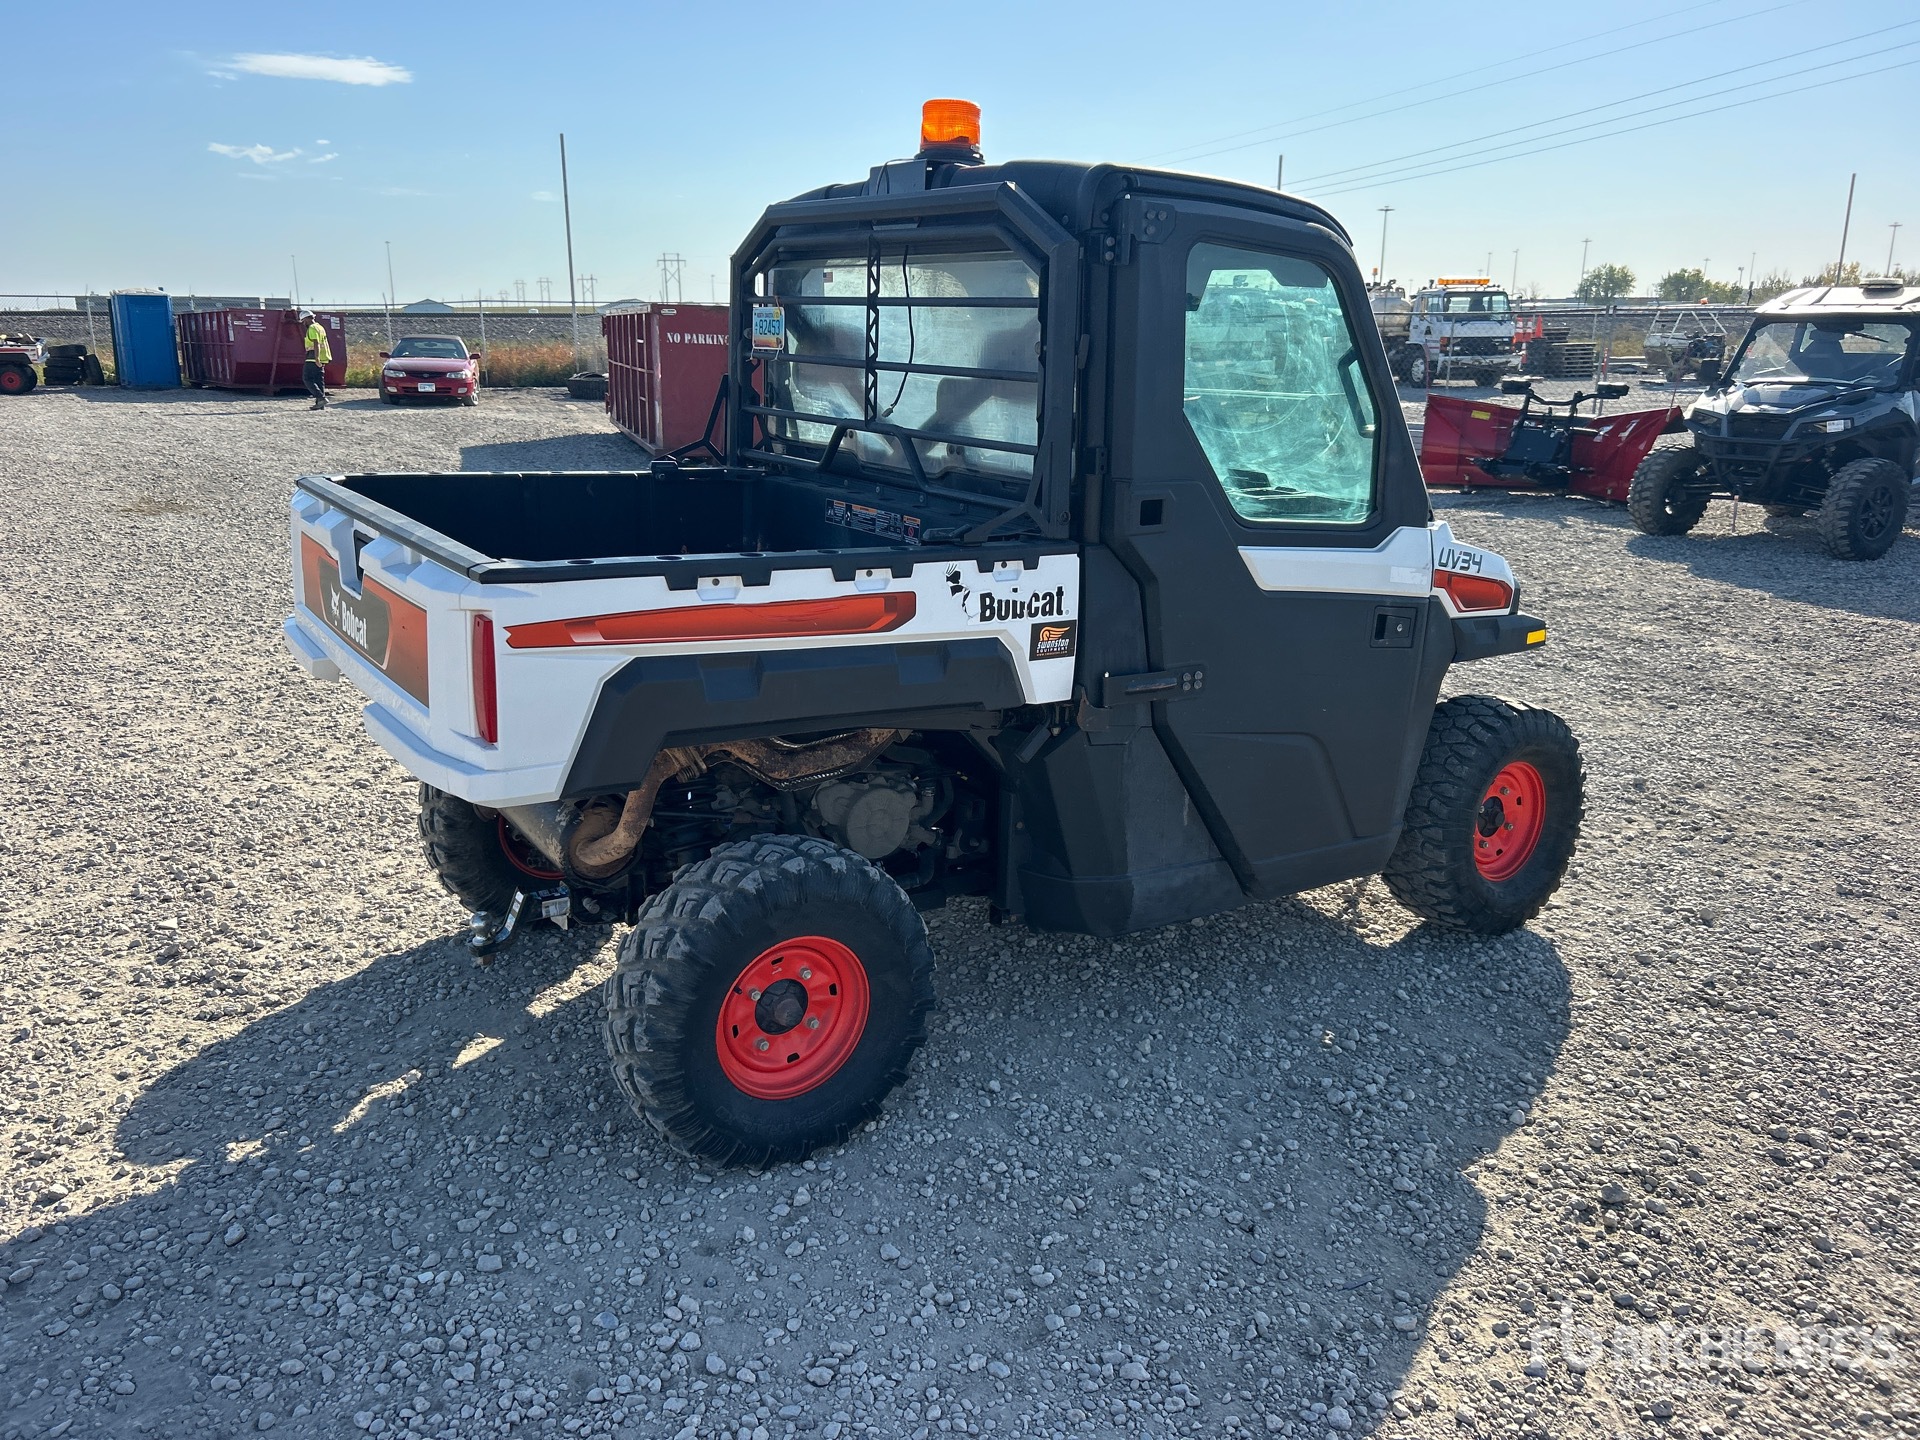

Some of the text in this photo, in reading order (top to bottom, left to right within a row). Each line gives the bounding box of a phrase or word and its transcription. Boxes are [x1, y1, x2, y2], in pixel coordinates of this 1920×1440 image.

[759, 319, 780, 335] 82453
[667, 333, 681, 343] NO
[1438, 547, 1483, 573] UV34
[341, 600, 367, 649] Bobcat
